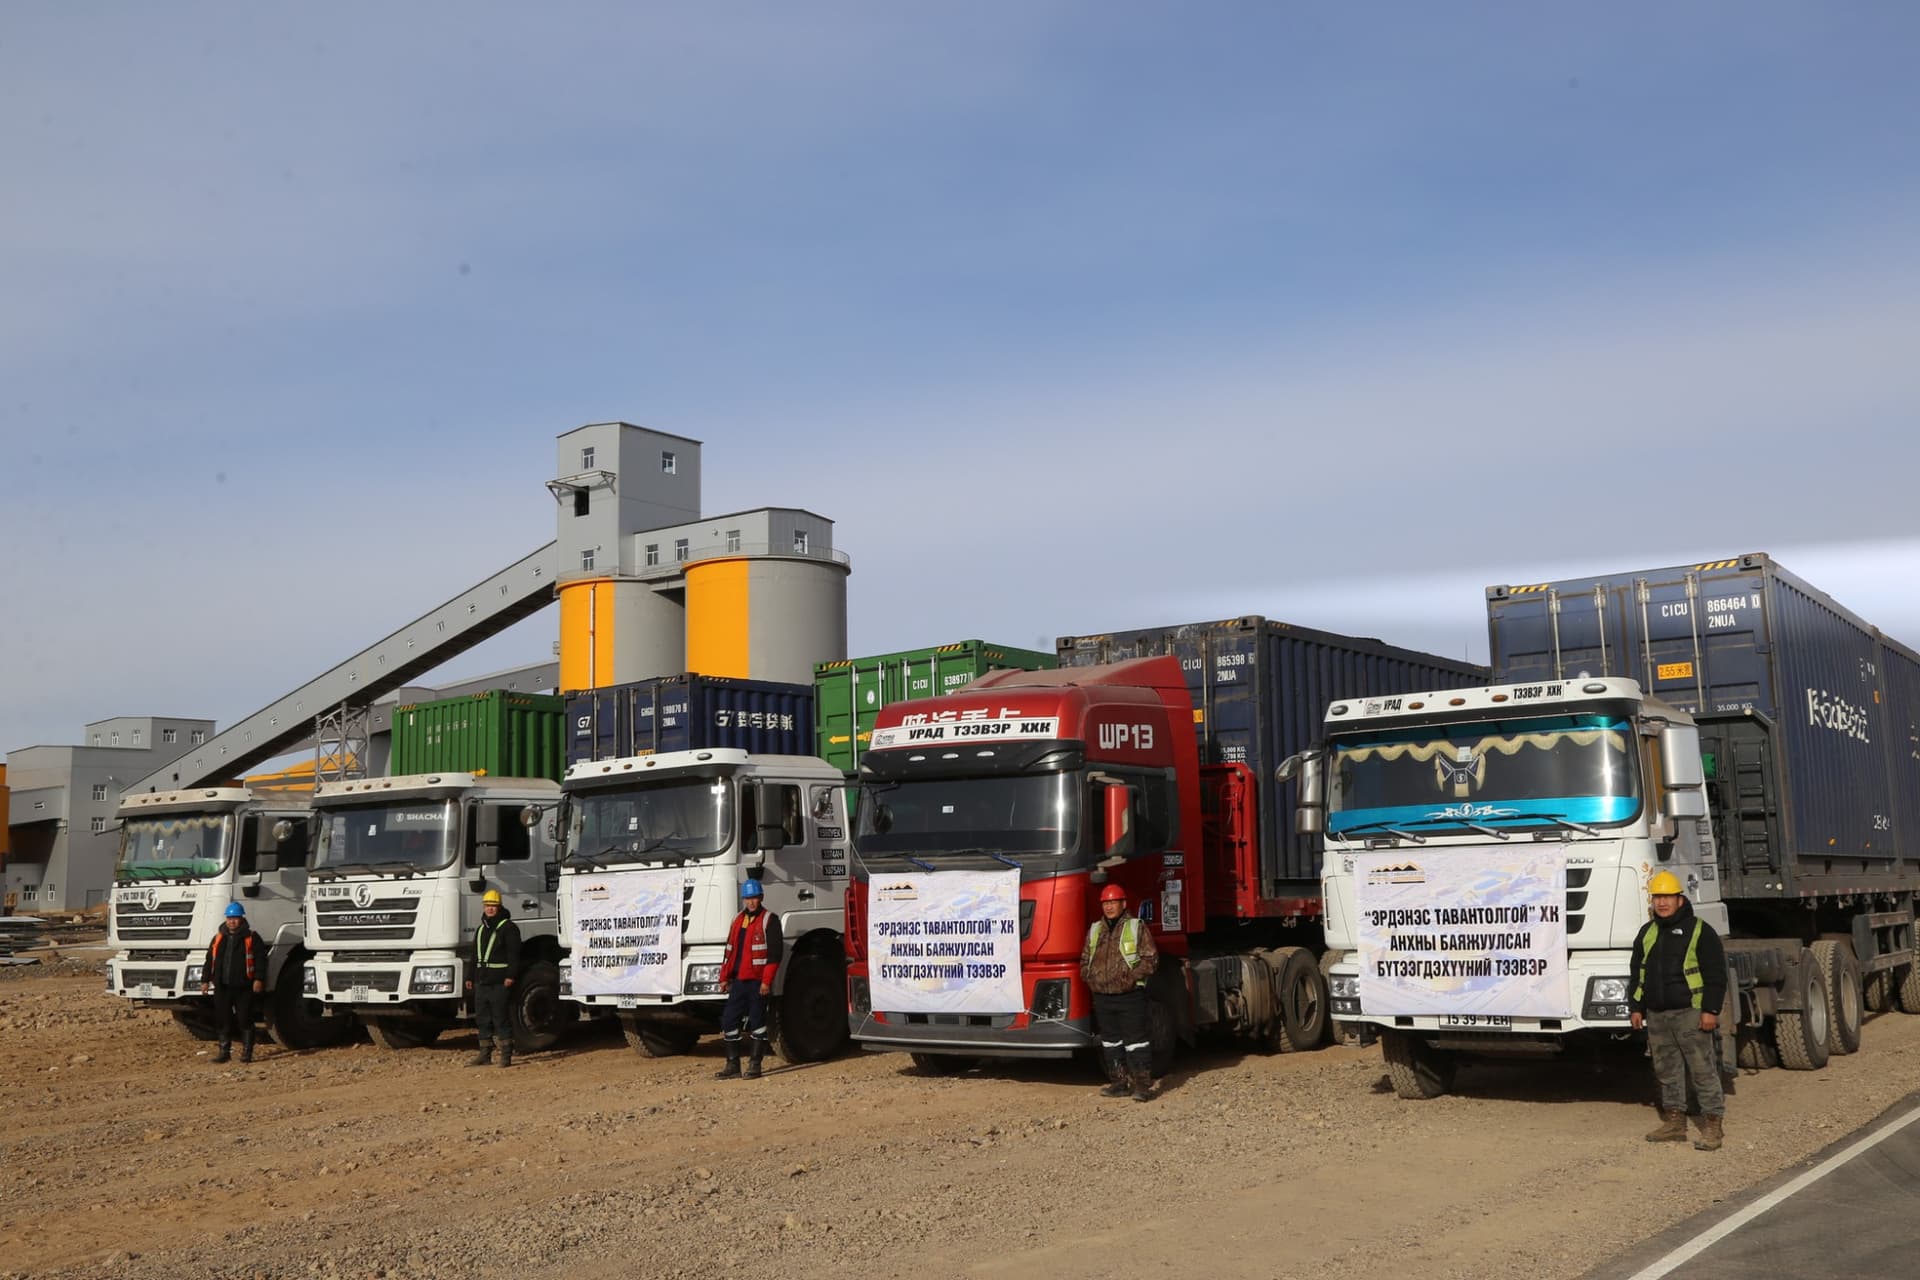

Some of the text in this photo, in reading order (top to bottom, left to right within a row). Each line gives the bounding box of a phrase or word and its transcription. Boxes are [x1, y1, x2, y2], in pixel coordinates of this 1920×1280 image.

[1662, 603, 1688, 617] CICU
[1707, 596, 1747, 613] 866464
[1708, 614, 1736, 628] 2NUA
[1182, 658, 1202, 670] CICU
[1217, 654, 1245, 667] 865398
[1217, 670, 1237, 682] 2NUA
[912, 679, 928, 690] CICU
[1383, 699, 1402, 711] УРАД
[1513, 686, 1543, 699] ТЭЭВЭР
[1546, 685, 1562, 697] ХХК
[577, 716, 591, 728] G7
[909, 727, 944, 740] УРАД
[954, 724, 1011, 737] ТЭЭВЭР
[1020, 722, 1051, 734] ХХК
[1365, 905, 1559, 928] “ЭРДЭНЭС ТАВАНТОЛГОЙ” ХК
[874, 918, 1014, 937] “ЭРДЭНЭС ТАВАНТОЛГОЙ” ХК
[589, 936, 614, 949] АНХНЫ
[890, 942, 994, 957] АНХНЫ БАЯЖУУЛСАН
[1390, 932, 1531, 951] АНХНЫ БАЯЖУУЛСАН
[882, 963, 1006, 980] БҮТЭЭГДЭХҮҮНИЙ ТЭЭВЭР
[1377, 958, 1547, 979] БҮТЭЭГДЭХҮҮНИЙ ТЭЭВЭР
[1448, 1014, 1459, 1024] 15
[1463, 1014, 1476, 1025] 39
